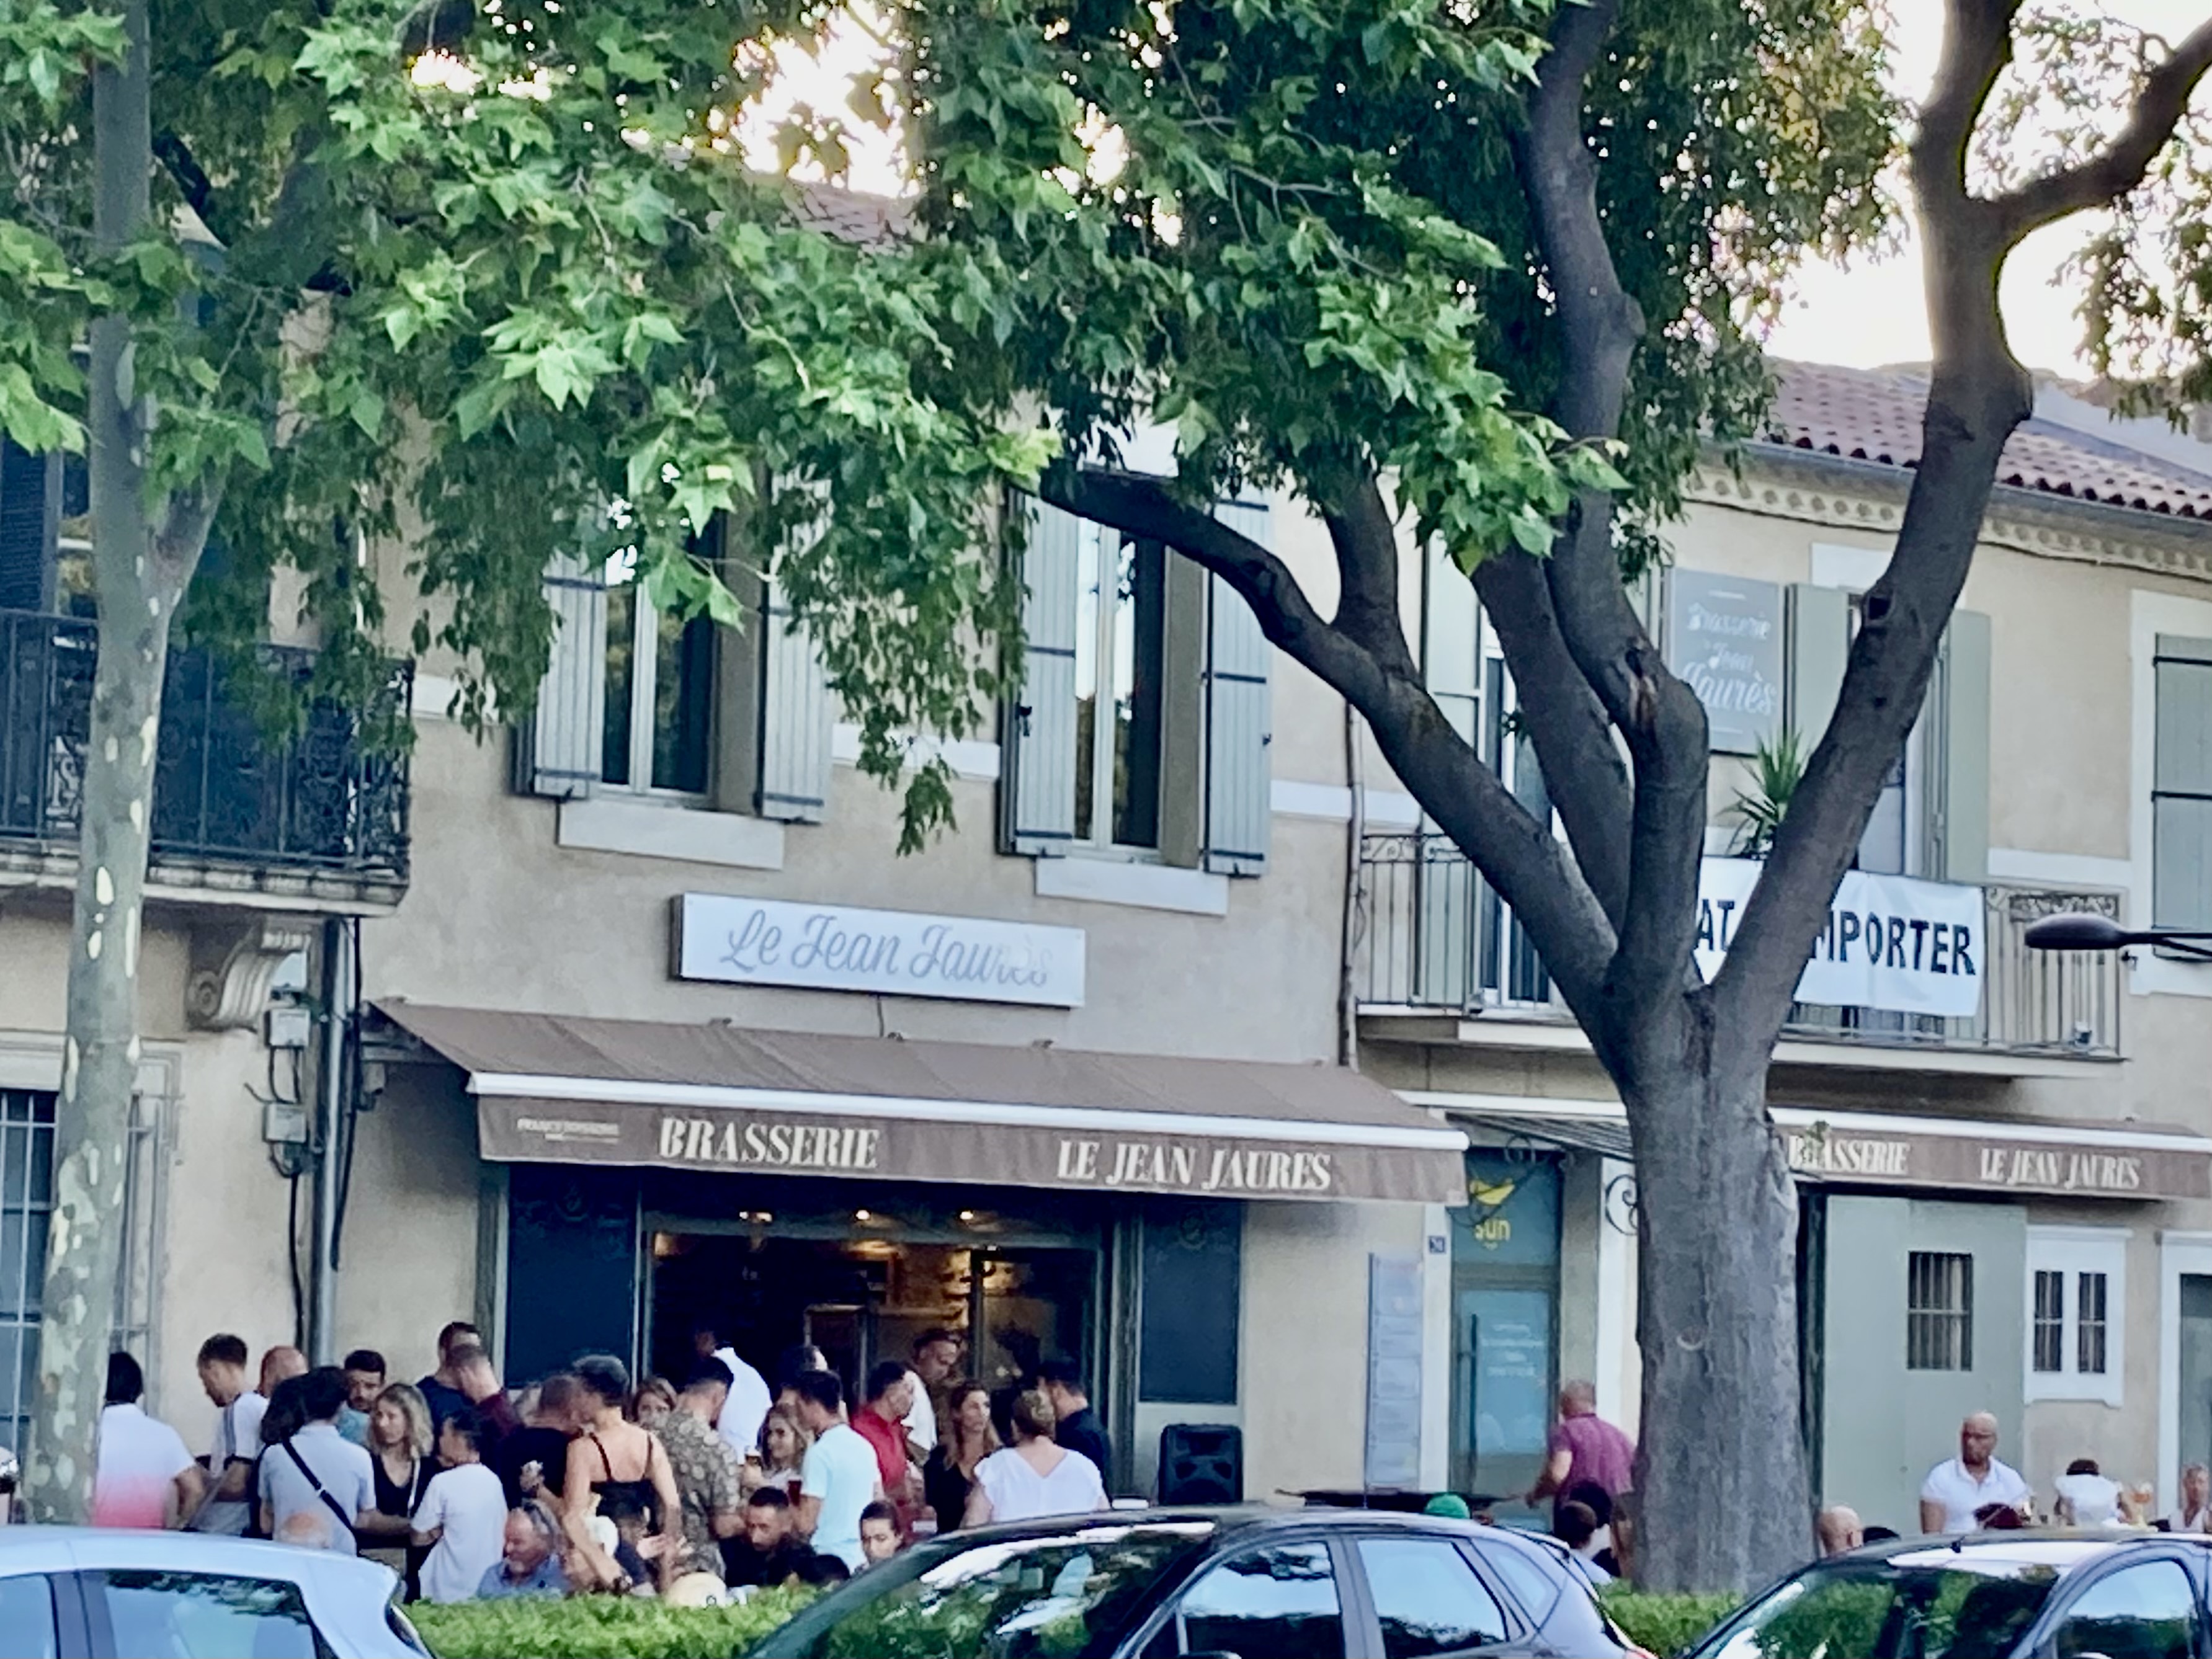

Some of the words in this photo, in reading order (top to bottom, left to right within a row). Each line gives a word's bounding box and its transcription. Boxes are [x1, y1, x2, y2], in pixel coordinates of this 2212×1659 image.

[719, 909, 782, 974] Le
[790, 914, 901, 975] Jean
[1695, 899, 1735, 951] AT
[1811, 909, 1976, 976] MPORTER
[659, 1118, 880, 1169] BRASSERIE
[1058, 1140, 1100, 1179] LE
[1105, 1142, 1197, 1185] JEAN
[1981, 1147, 2008, 1182] LE
[2007, 1149, 2064, 1186] JEAN
